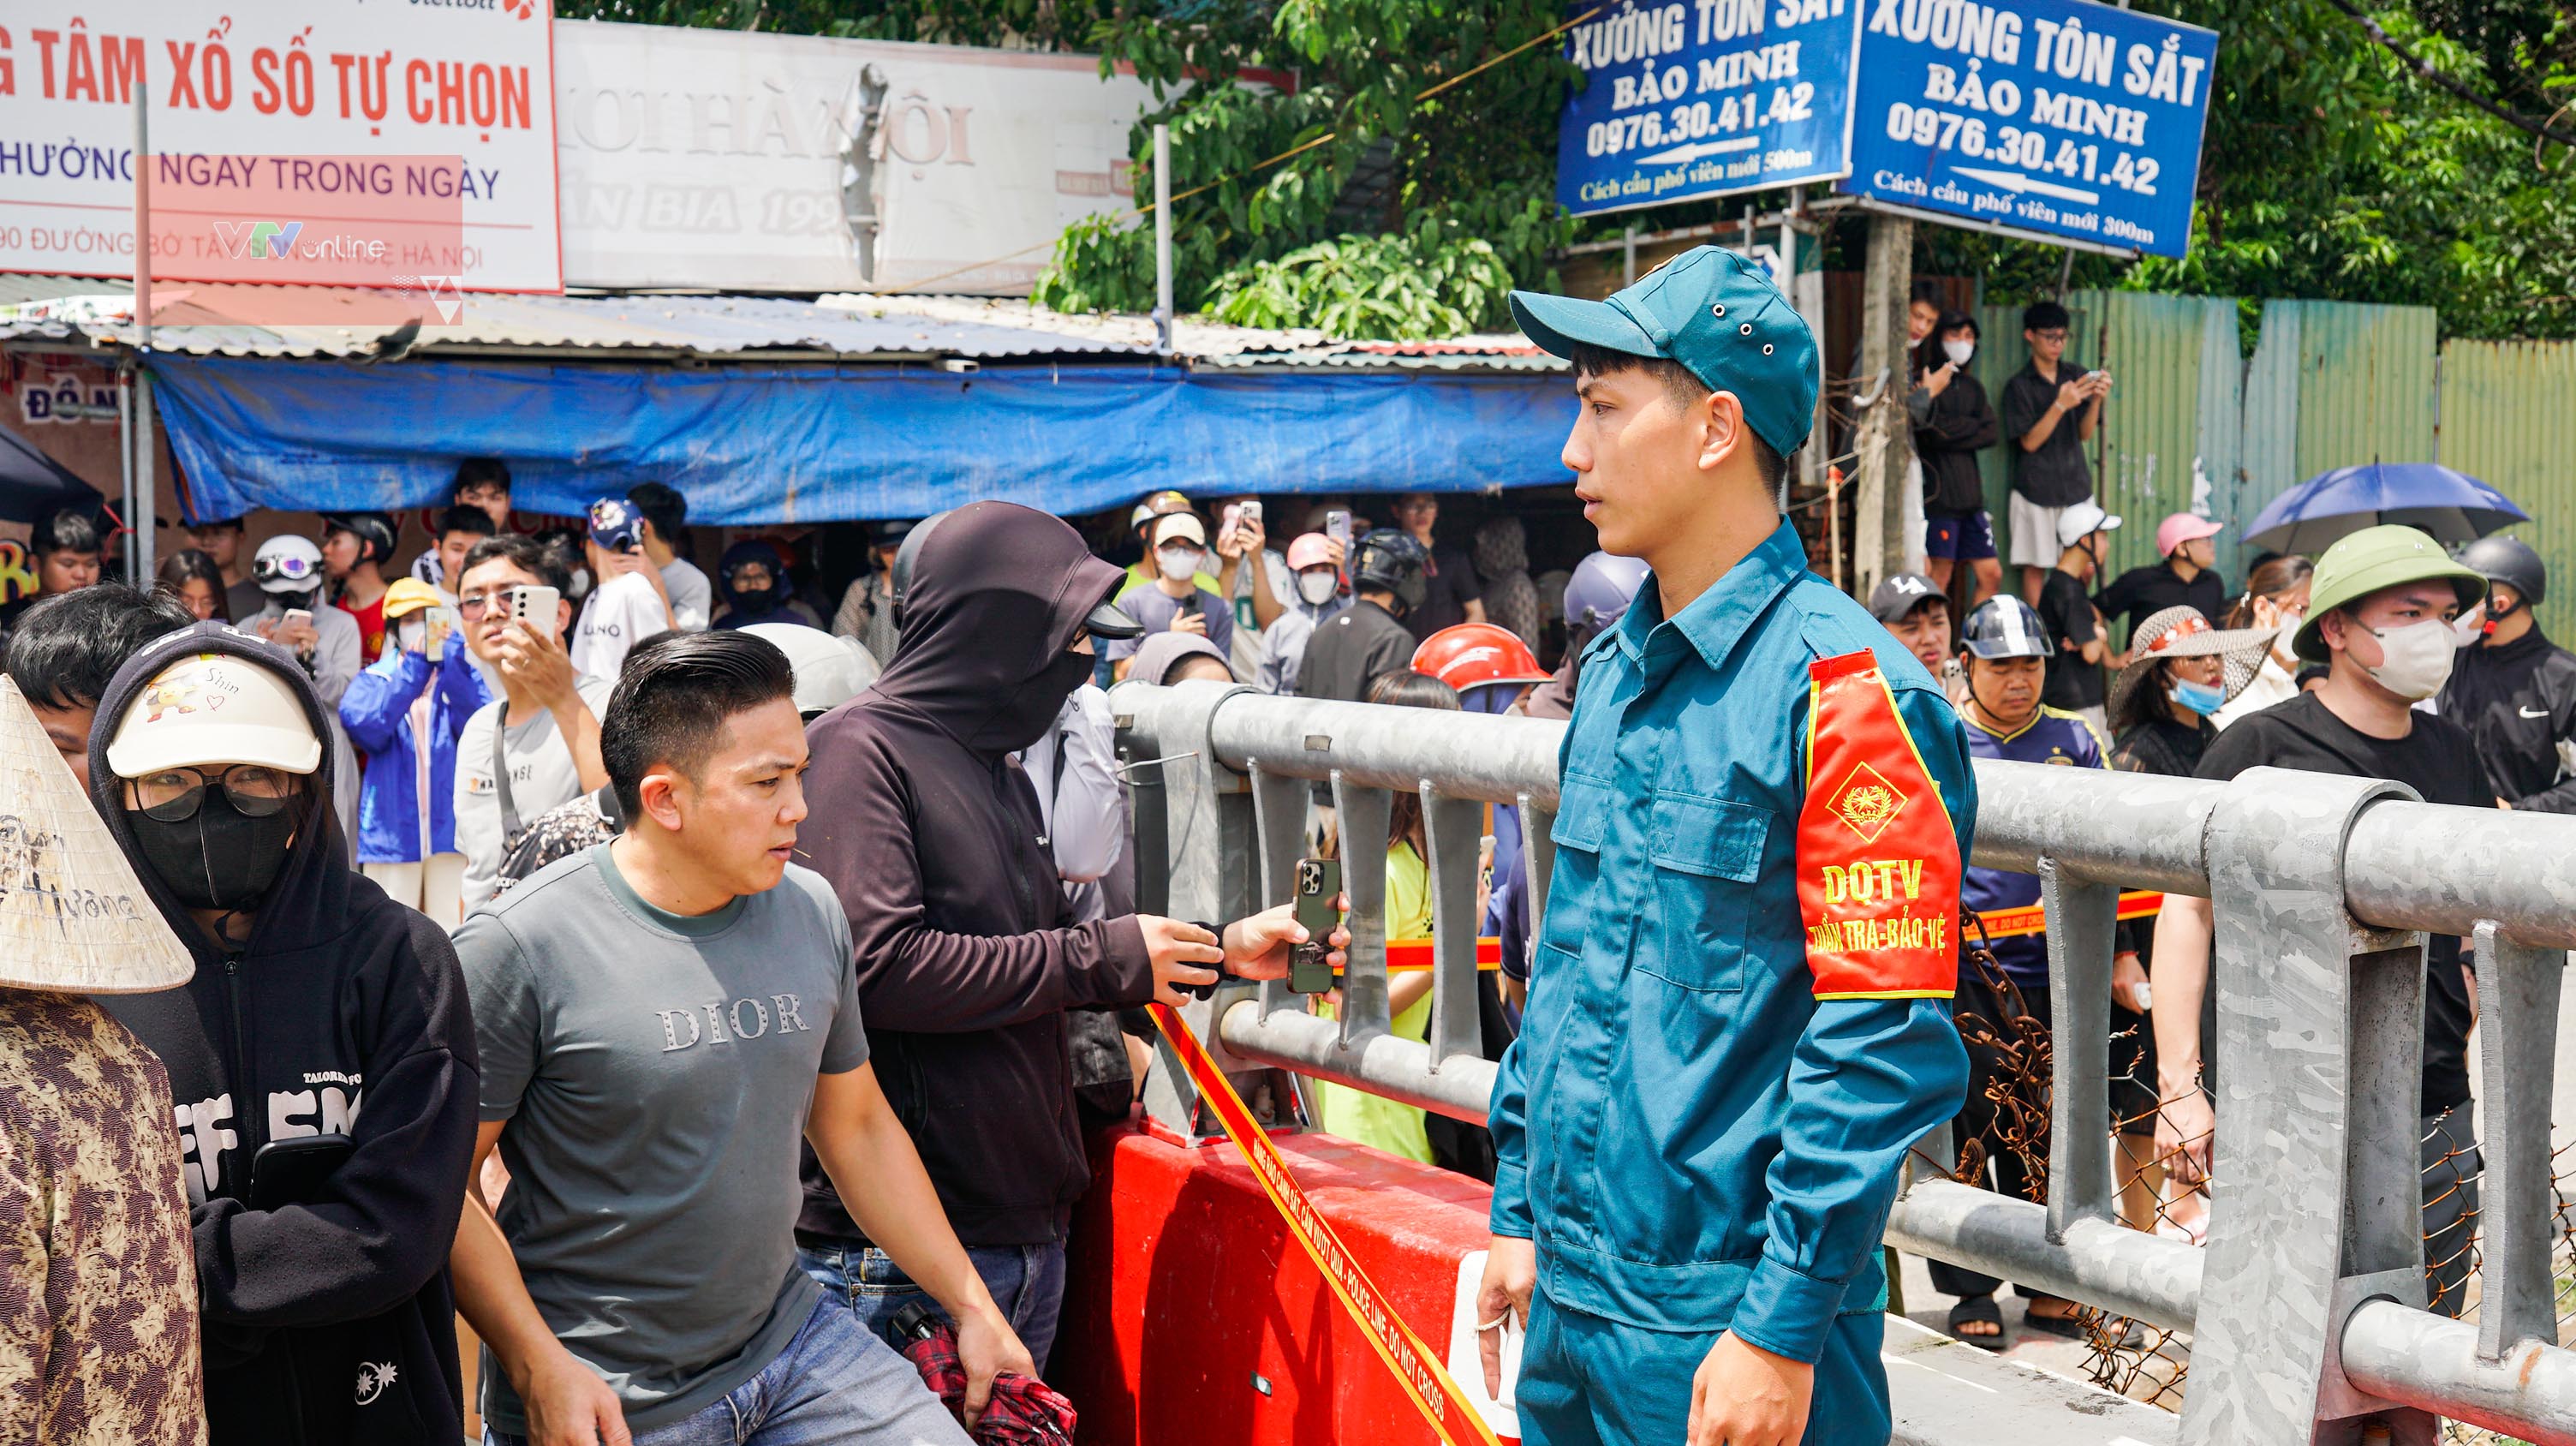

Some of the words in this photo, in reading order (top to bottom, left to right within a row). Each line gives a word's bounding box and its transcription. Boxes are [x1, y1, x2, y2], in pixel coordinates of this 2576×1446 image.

[31, 16, 147, 105] TÂM
[165, 15, 233, 111] XỔ
[251, 26, 314, 117] SỐ
[331, 50, 391, 137] TỰ
[406, 58, 531, 143] CHỌN
[1612, 58, 1689, 111] BẢO
[1695, 40, 1801, 94] MINH
[2034, 16, 2117, 87] TÔN
[2123, 33, 2205, 107] SẮT
[1586, 82, 1815, 158] 0976.30.41.42
[1923, 57, 2022, 117] BẢO
[2030, 87, 2149, 146] MINH
[159, 152, 257, 188] NGAY
[269, 158, 393, 195] TRONG
[405, 159, 499, 200] NGÀY
[1580, 181, 1619, 202] Cách
[1763, 148, 1813, 172] 500m
[1887, 102, 2160, 196] 0976.30.41.42
[31, 225, 134, 255] ĐƯỜNG
[1873, 169, 1929, 198] Cách
[1931, 179, 1970, 206] cầu
[2017, 200, 2058, 224] viên
[2102, 216, 2156, 245] 300m
[1822, 859, 1923, 905] DQTV
[1808, 913, 1844, 953] TUẦN
[1928, 912, 1946, 957] VỆ
[655, 993, 811, 1053] DIOR
[1330, 1246, 1345, 1282] QUA
[1347, 1268, 1370, 1319] POLICE
[1388, 1325, 1400, 1359] DO
[1401, 1341, 1416, 1382] NOT
[1417, 1365, 1444, 1422] CROSS
